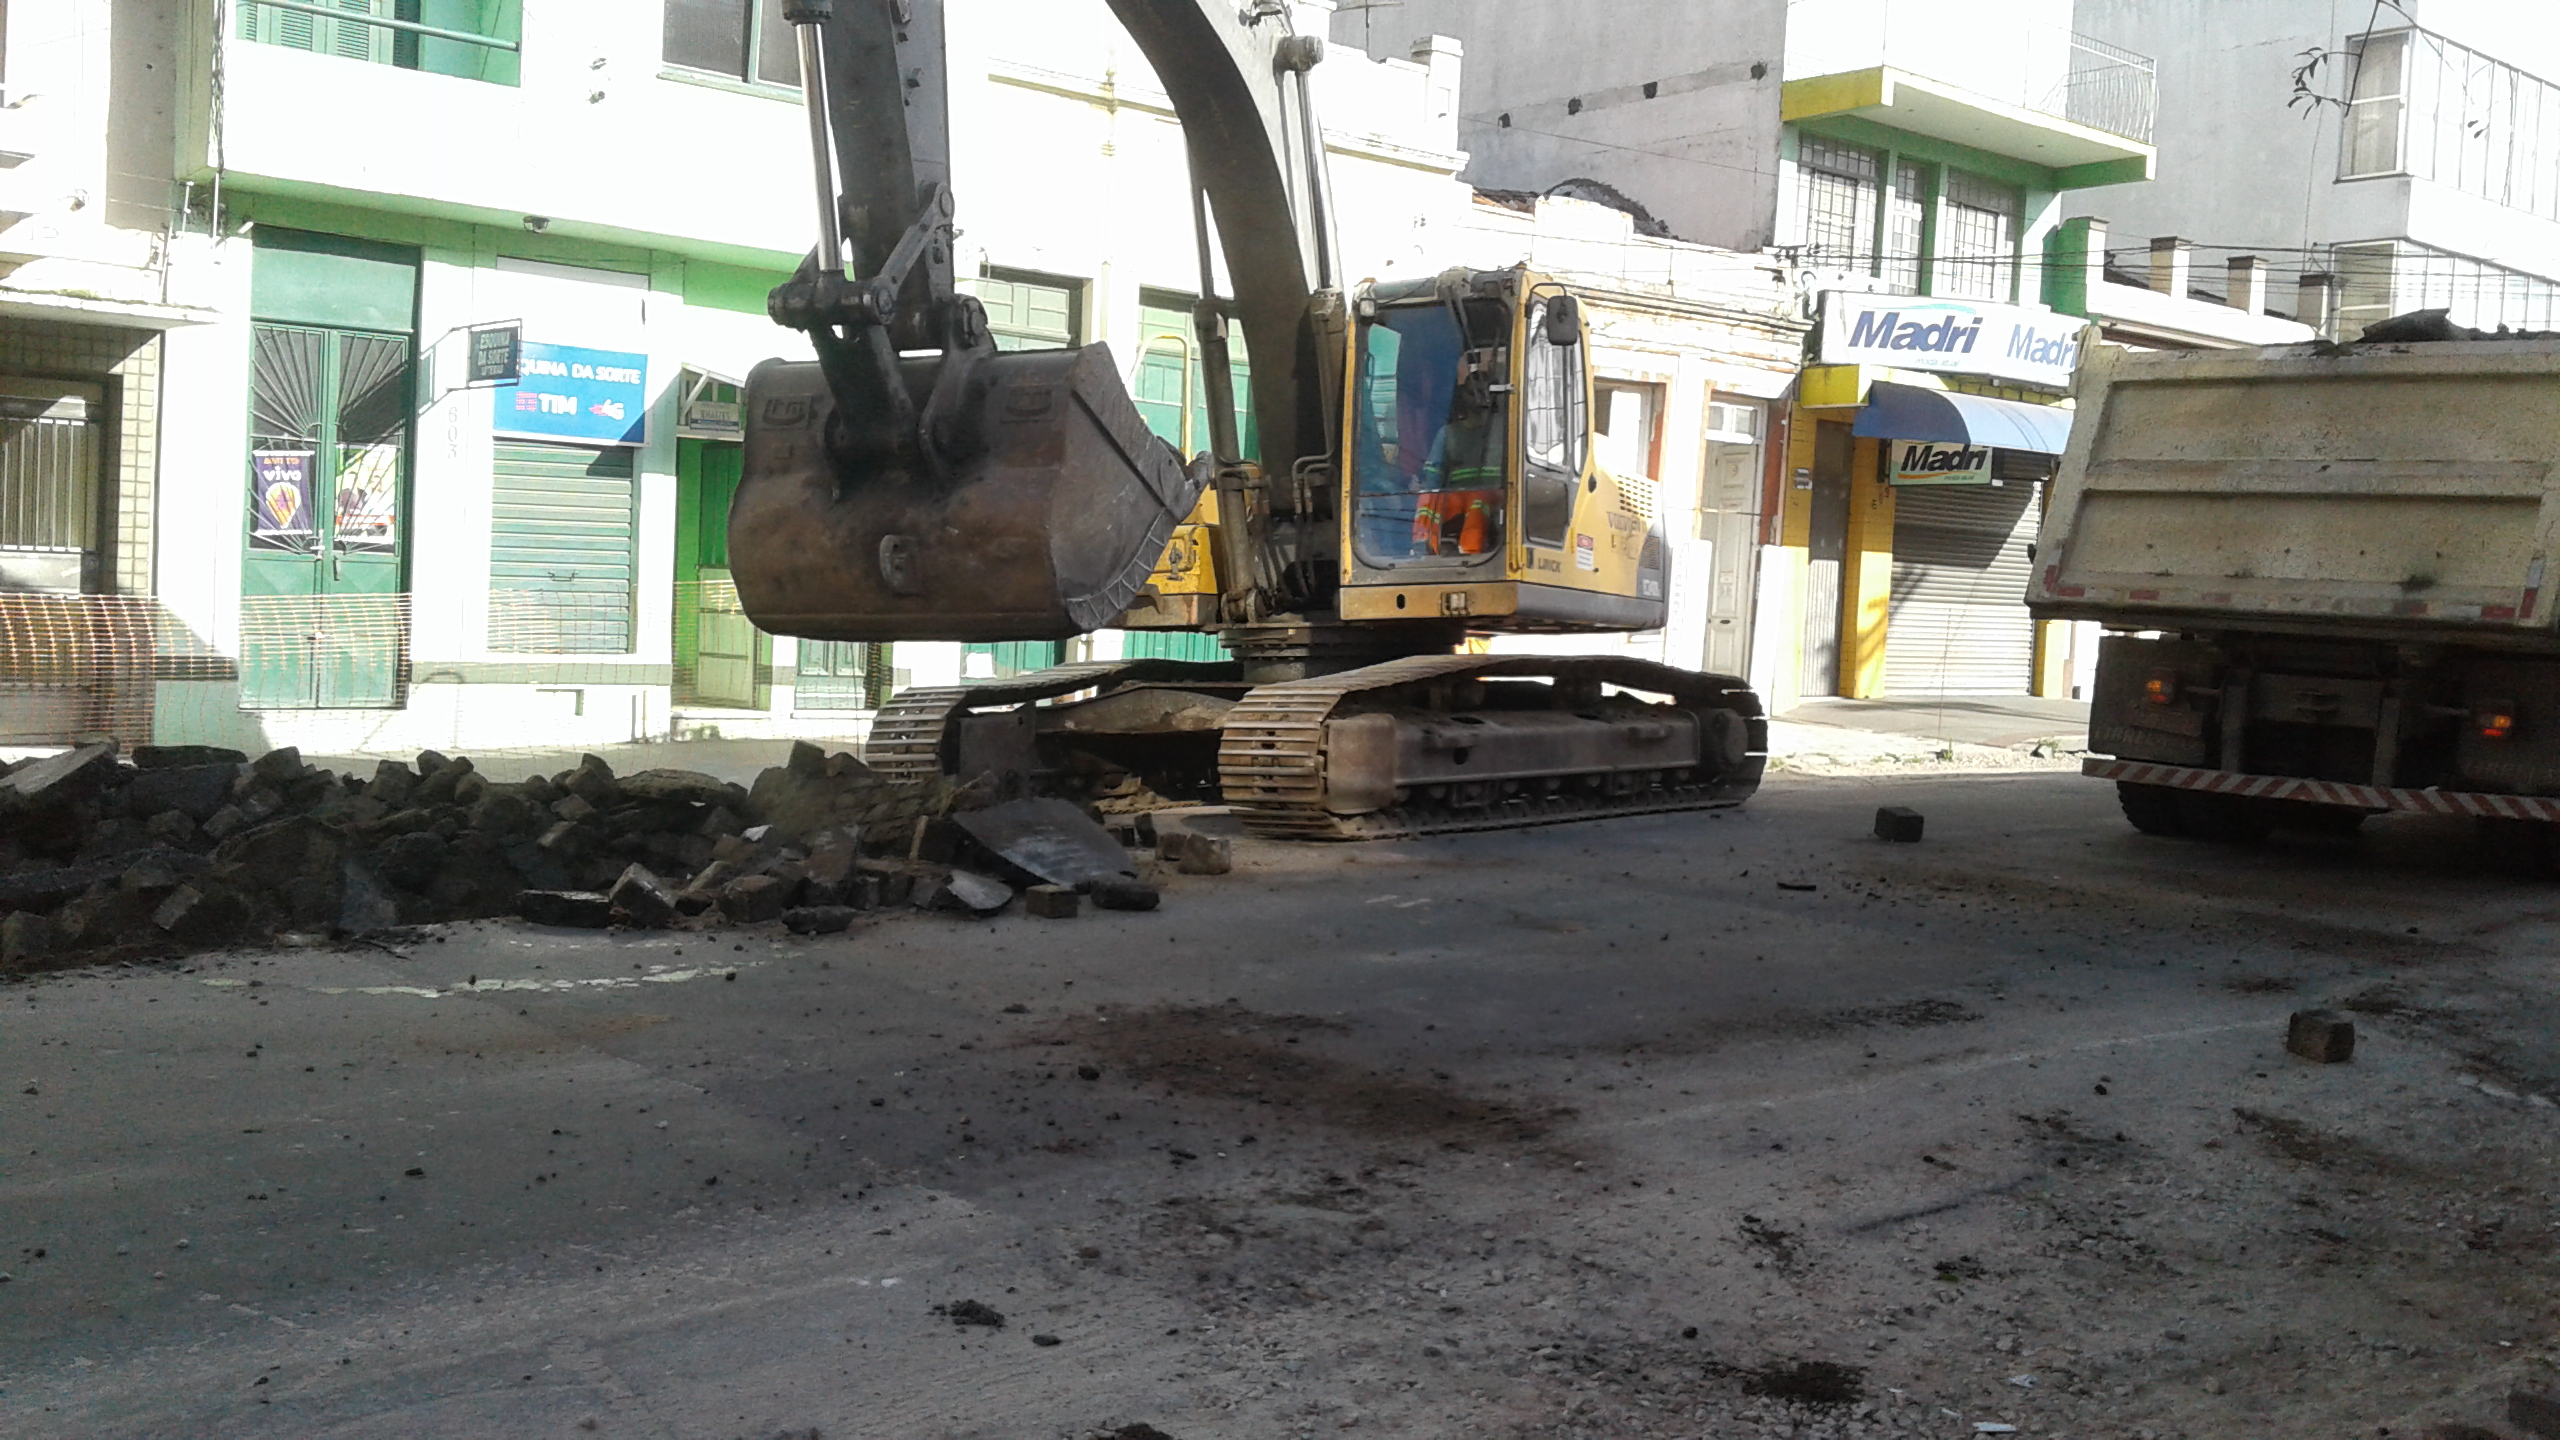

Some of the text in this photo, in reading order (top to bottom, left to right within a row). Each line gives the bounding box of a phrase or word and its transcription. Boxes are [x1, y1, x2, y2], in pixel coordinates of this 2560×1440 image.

[1848, 310, 1983, 353] Madri
[572, 363, 594, 380] DA
[595, 366, 641, 384] SORTE
[538, 393, 578, 415] TIM
[1901, 443, 1989, 472] Madri
[263, 466, 302, 481] vivo
